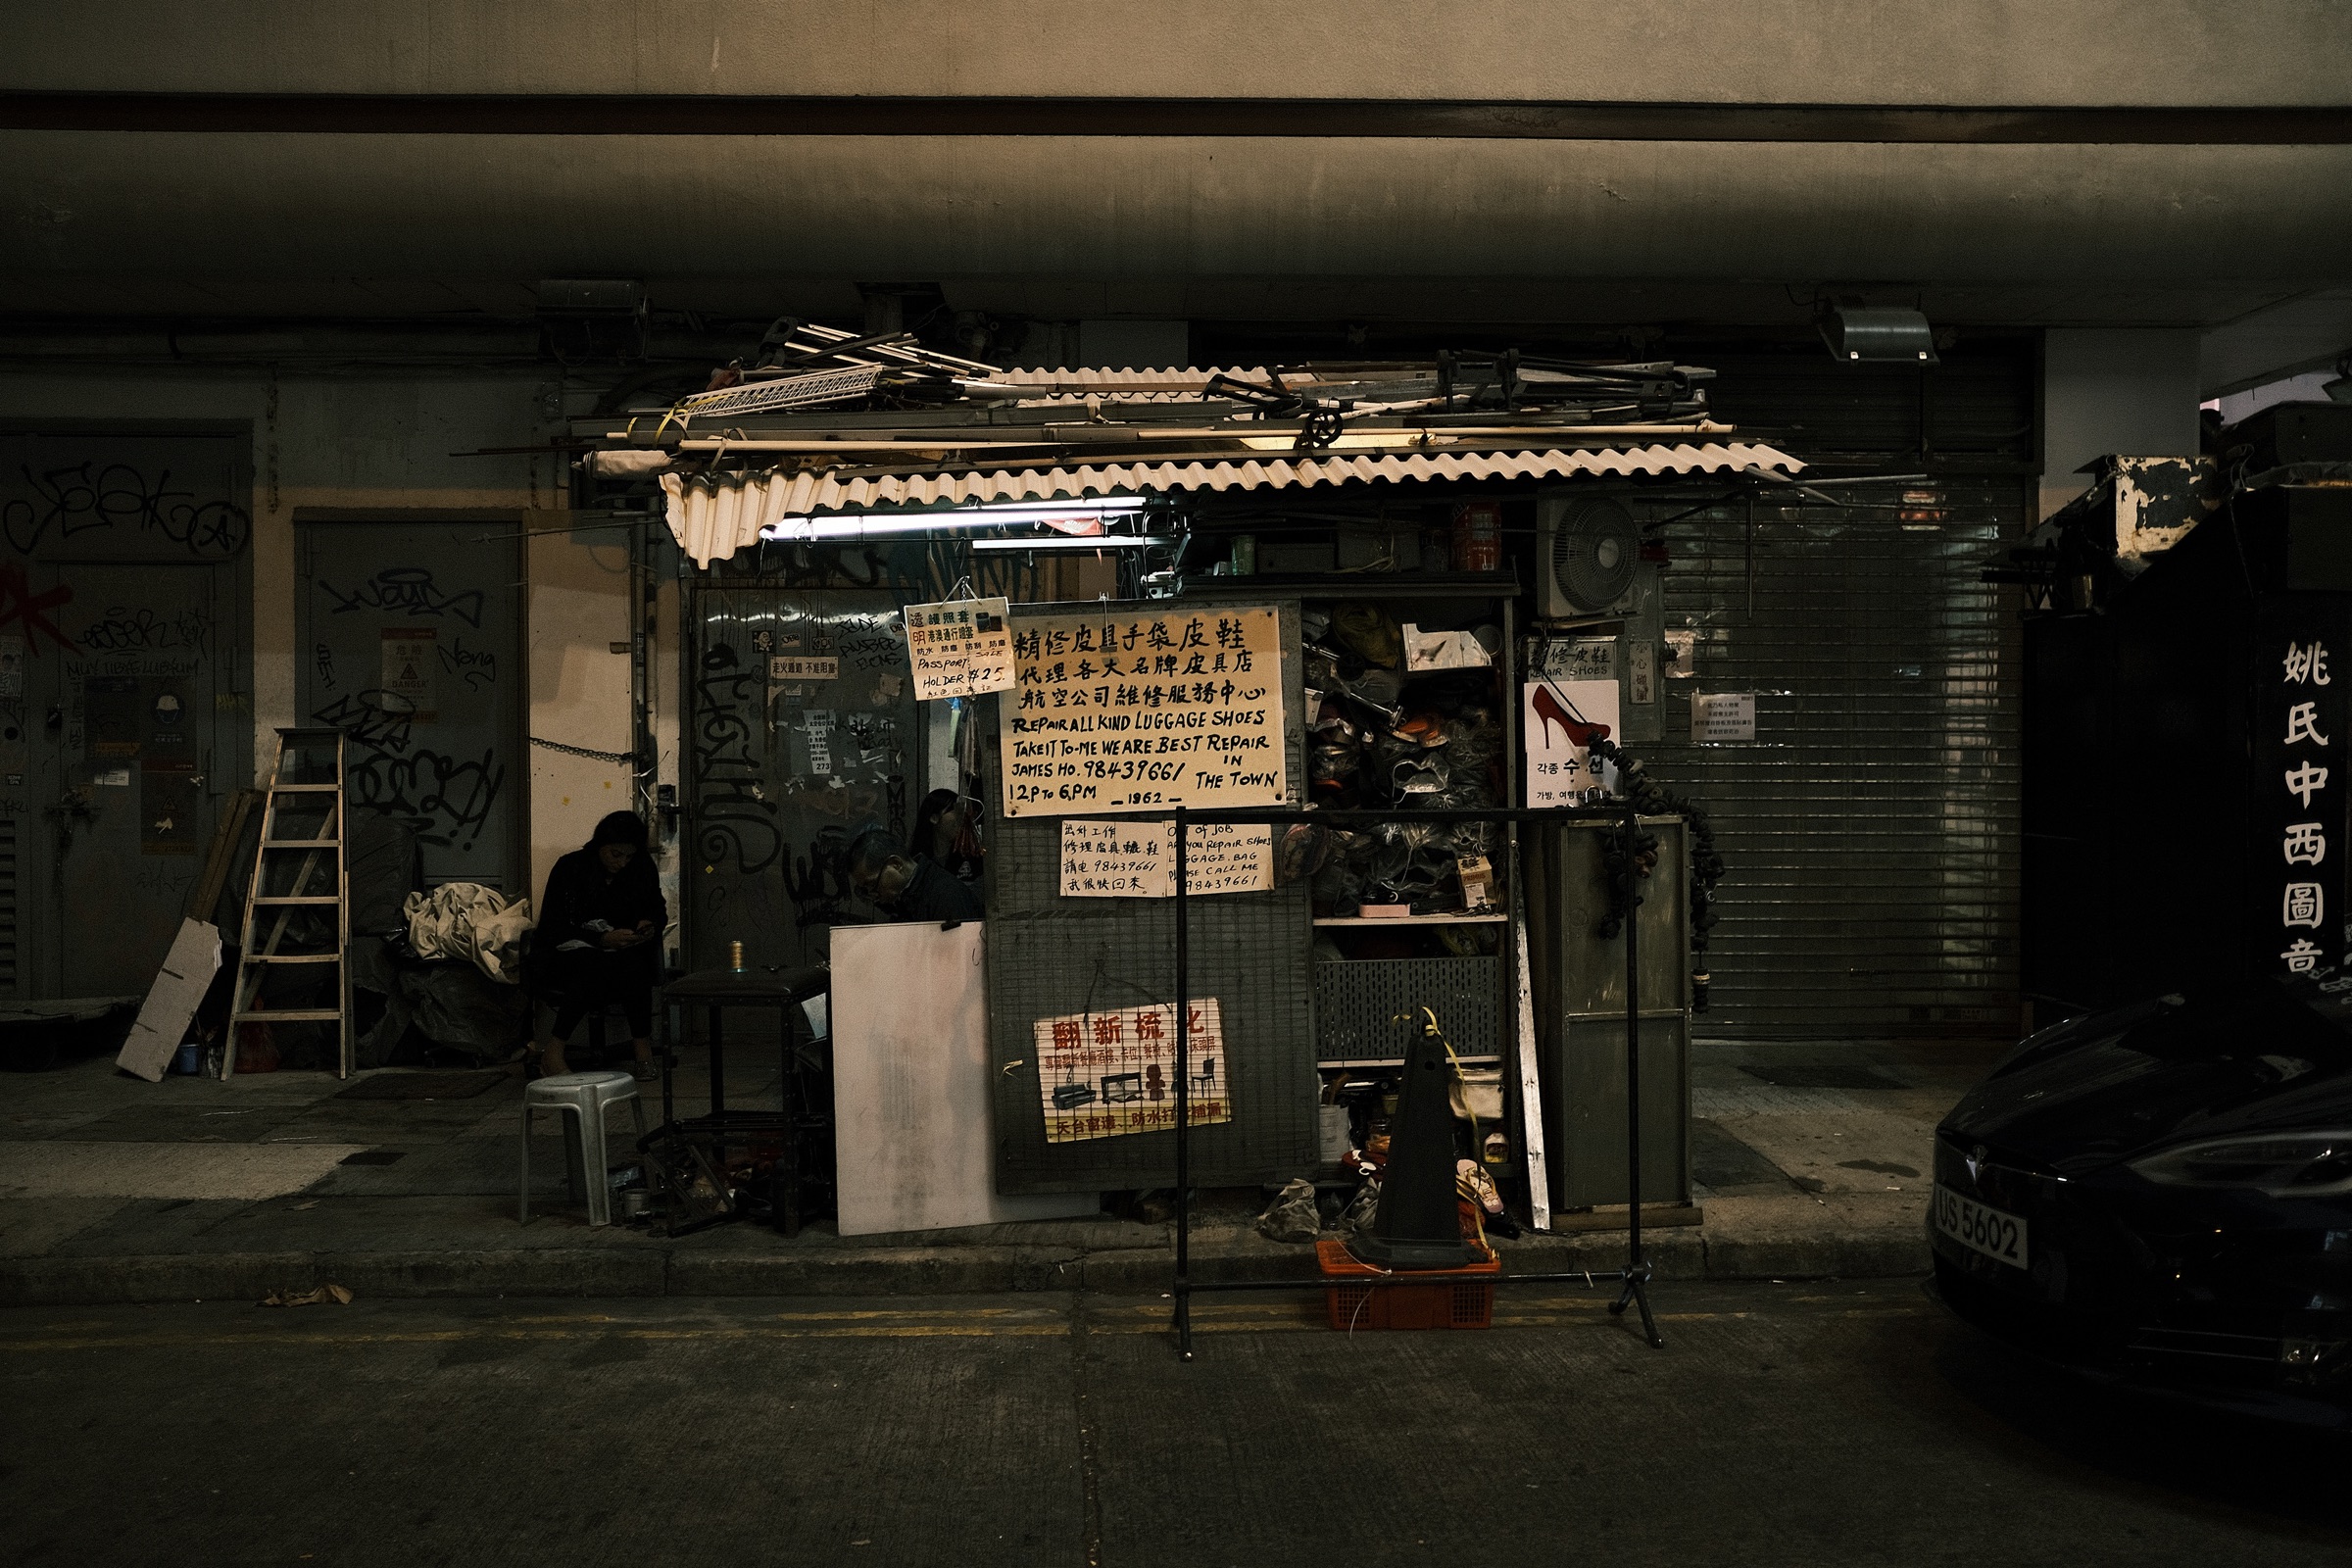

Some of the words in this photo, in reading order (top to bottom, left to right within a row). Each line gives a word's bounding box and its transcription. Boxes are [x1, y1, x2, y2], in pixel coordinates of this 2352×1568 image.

[772, 662, 803, 674] 走火通道
[805, 662, 837, 674] 不准阻塞
[918, 659, 967, 671] PASSPORT
[1019, 649, 1253, 686] 代理各大名牌皮具店
[1570, 665, 1608, 676] SHOES
[923, 674, 964, 688] HOLDER
[1017, 679, 1266, 710] 航空公司維修服務中心
[1011, 717, 1069, 734] REPAIR
[1069, 716, 1095, 732] ALL
[1098, 715, 1131, 731] KIND
[1135, 710, 1206, 730] LUGGAGE
[1211, 710, 1266, 726] SHOES
[1155, 735, 1203, 754] BEST
[1206, 734, 1270, 752] REPAIR
[1223, 755, 1243, 766] IN
[1011, 762, 1054, 777] JAMES
[1083, 760, 1186, 781] 98439661
[1537, 762, 1559, 774] 각종
[1196, 771, 1224, 789] THE
[1229, 770, 1279, 788] TOWN
[1064, 825, 1116, 839] 出外工作
[1233, 853, 1257, 862] BAG
[1094, 859, 1157, 872] 98439661
[1205, 864, 1237, 875] CALL
[1241, 863, 1259, 872] ME
[1938, 1189, 1959, 1233] US
[1962, 1201, 2019, 1260] 5602
